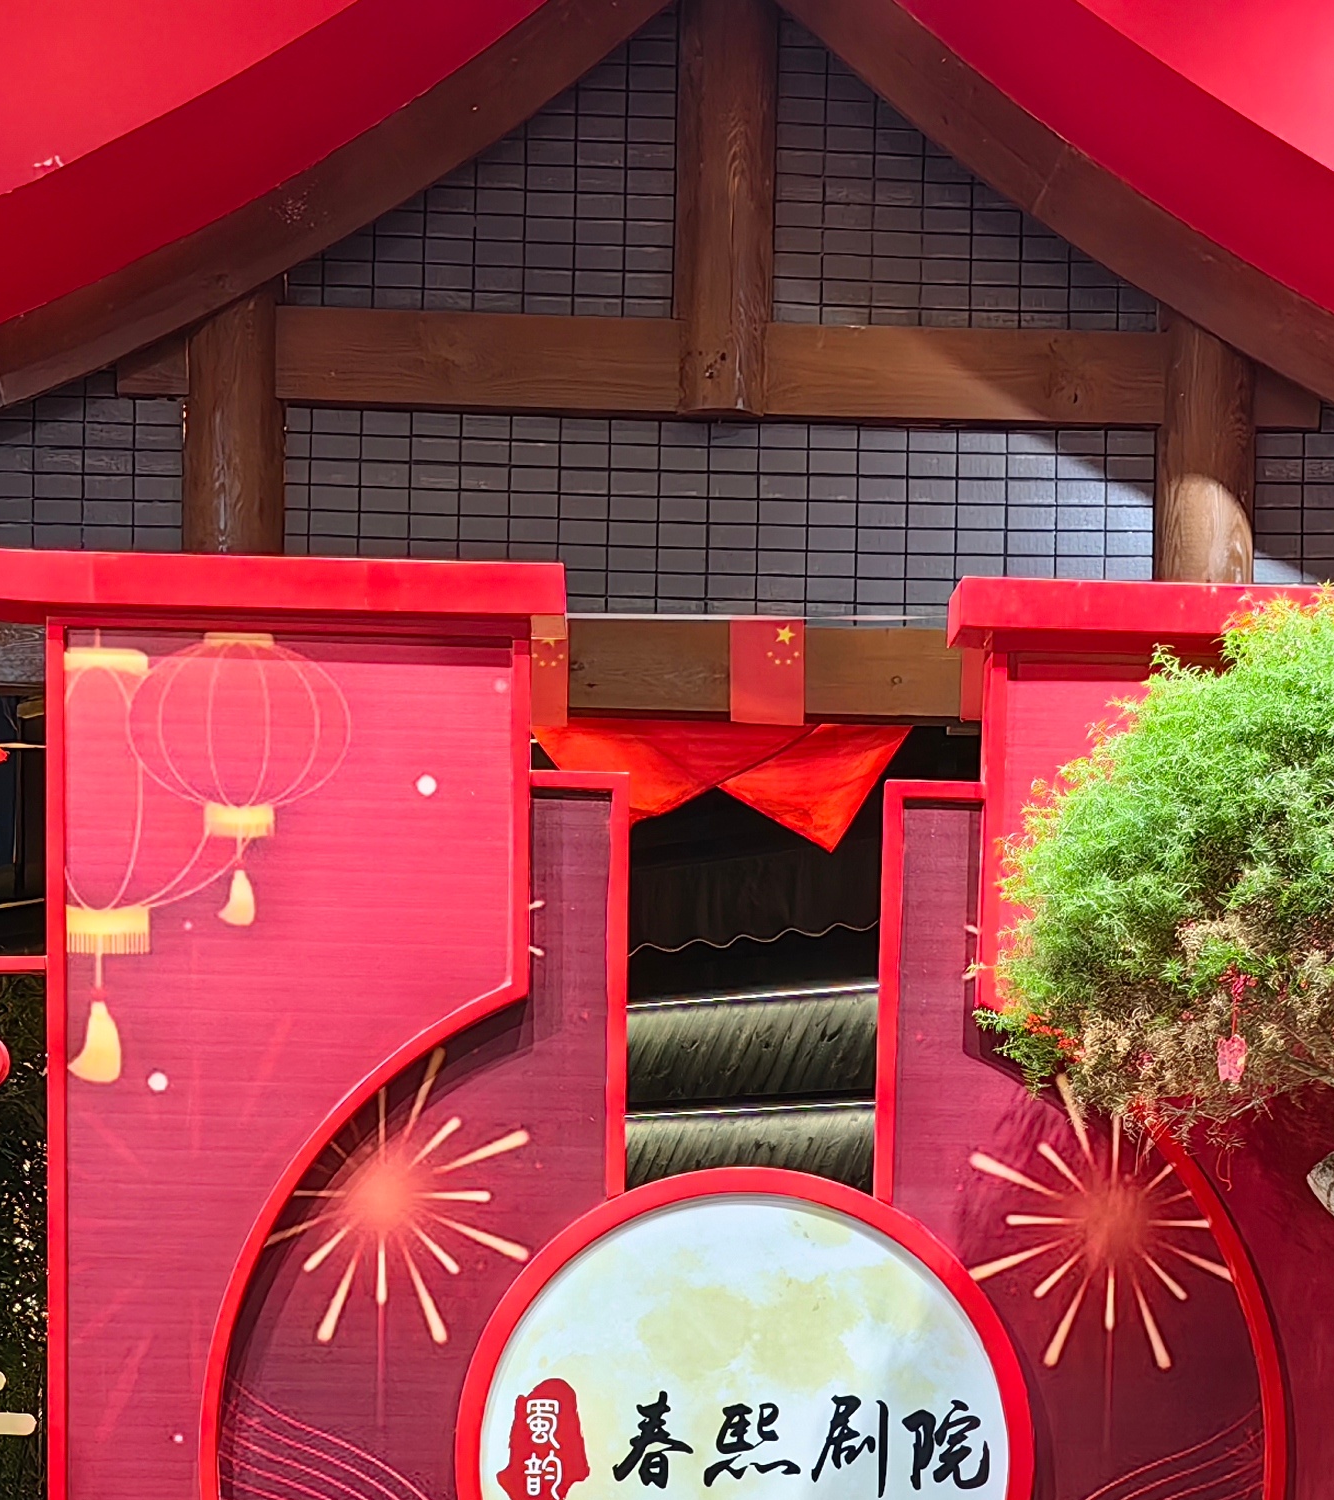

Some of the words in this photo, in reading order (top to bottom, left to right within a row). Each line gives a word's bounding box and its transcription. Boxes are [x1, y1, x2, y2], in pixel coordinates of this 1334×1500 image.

[524, 1399, 563, 1500] 蜀韵
[612, 1390, 990, 1499] 春熙剧院
